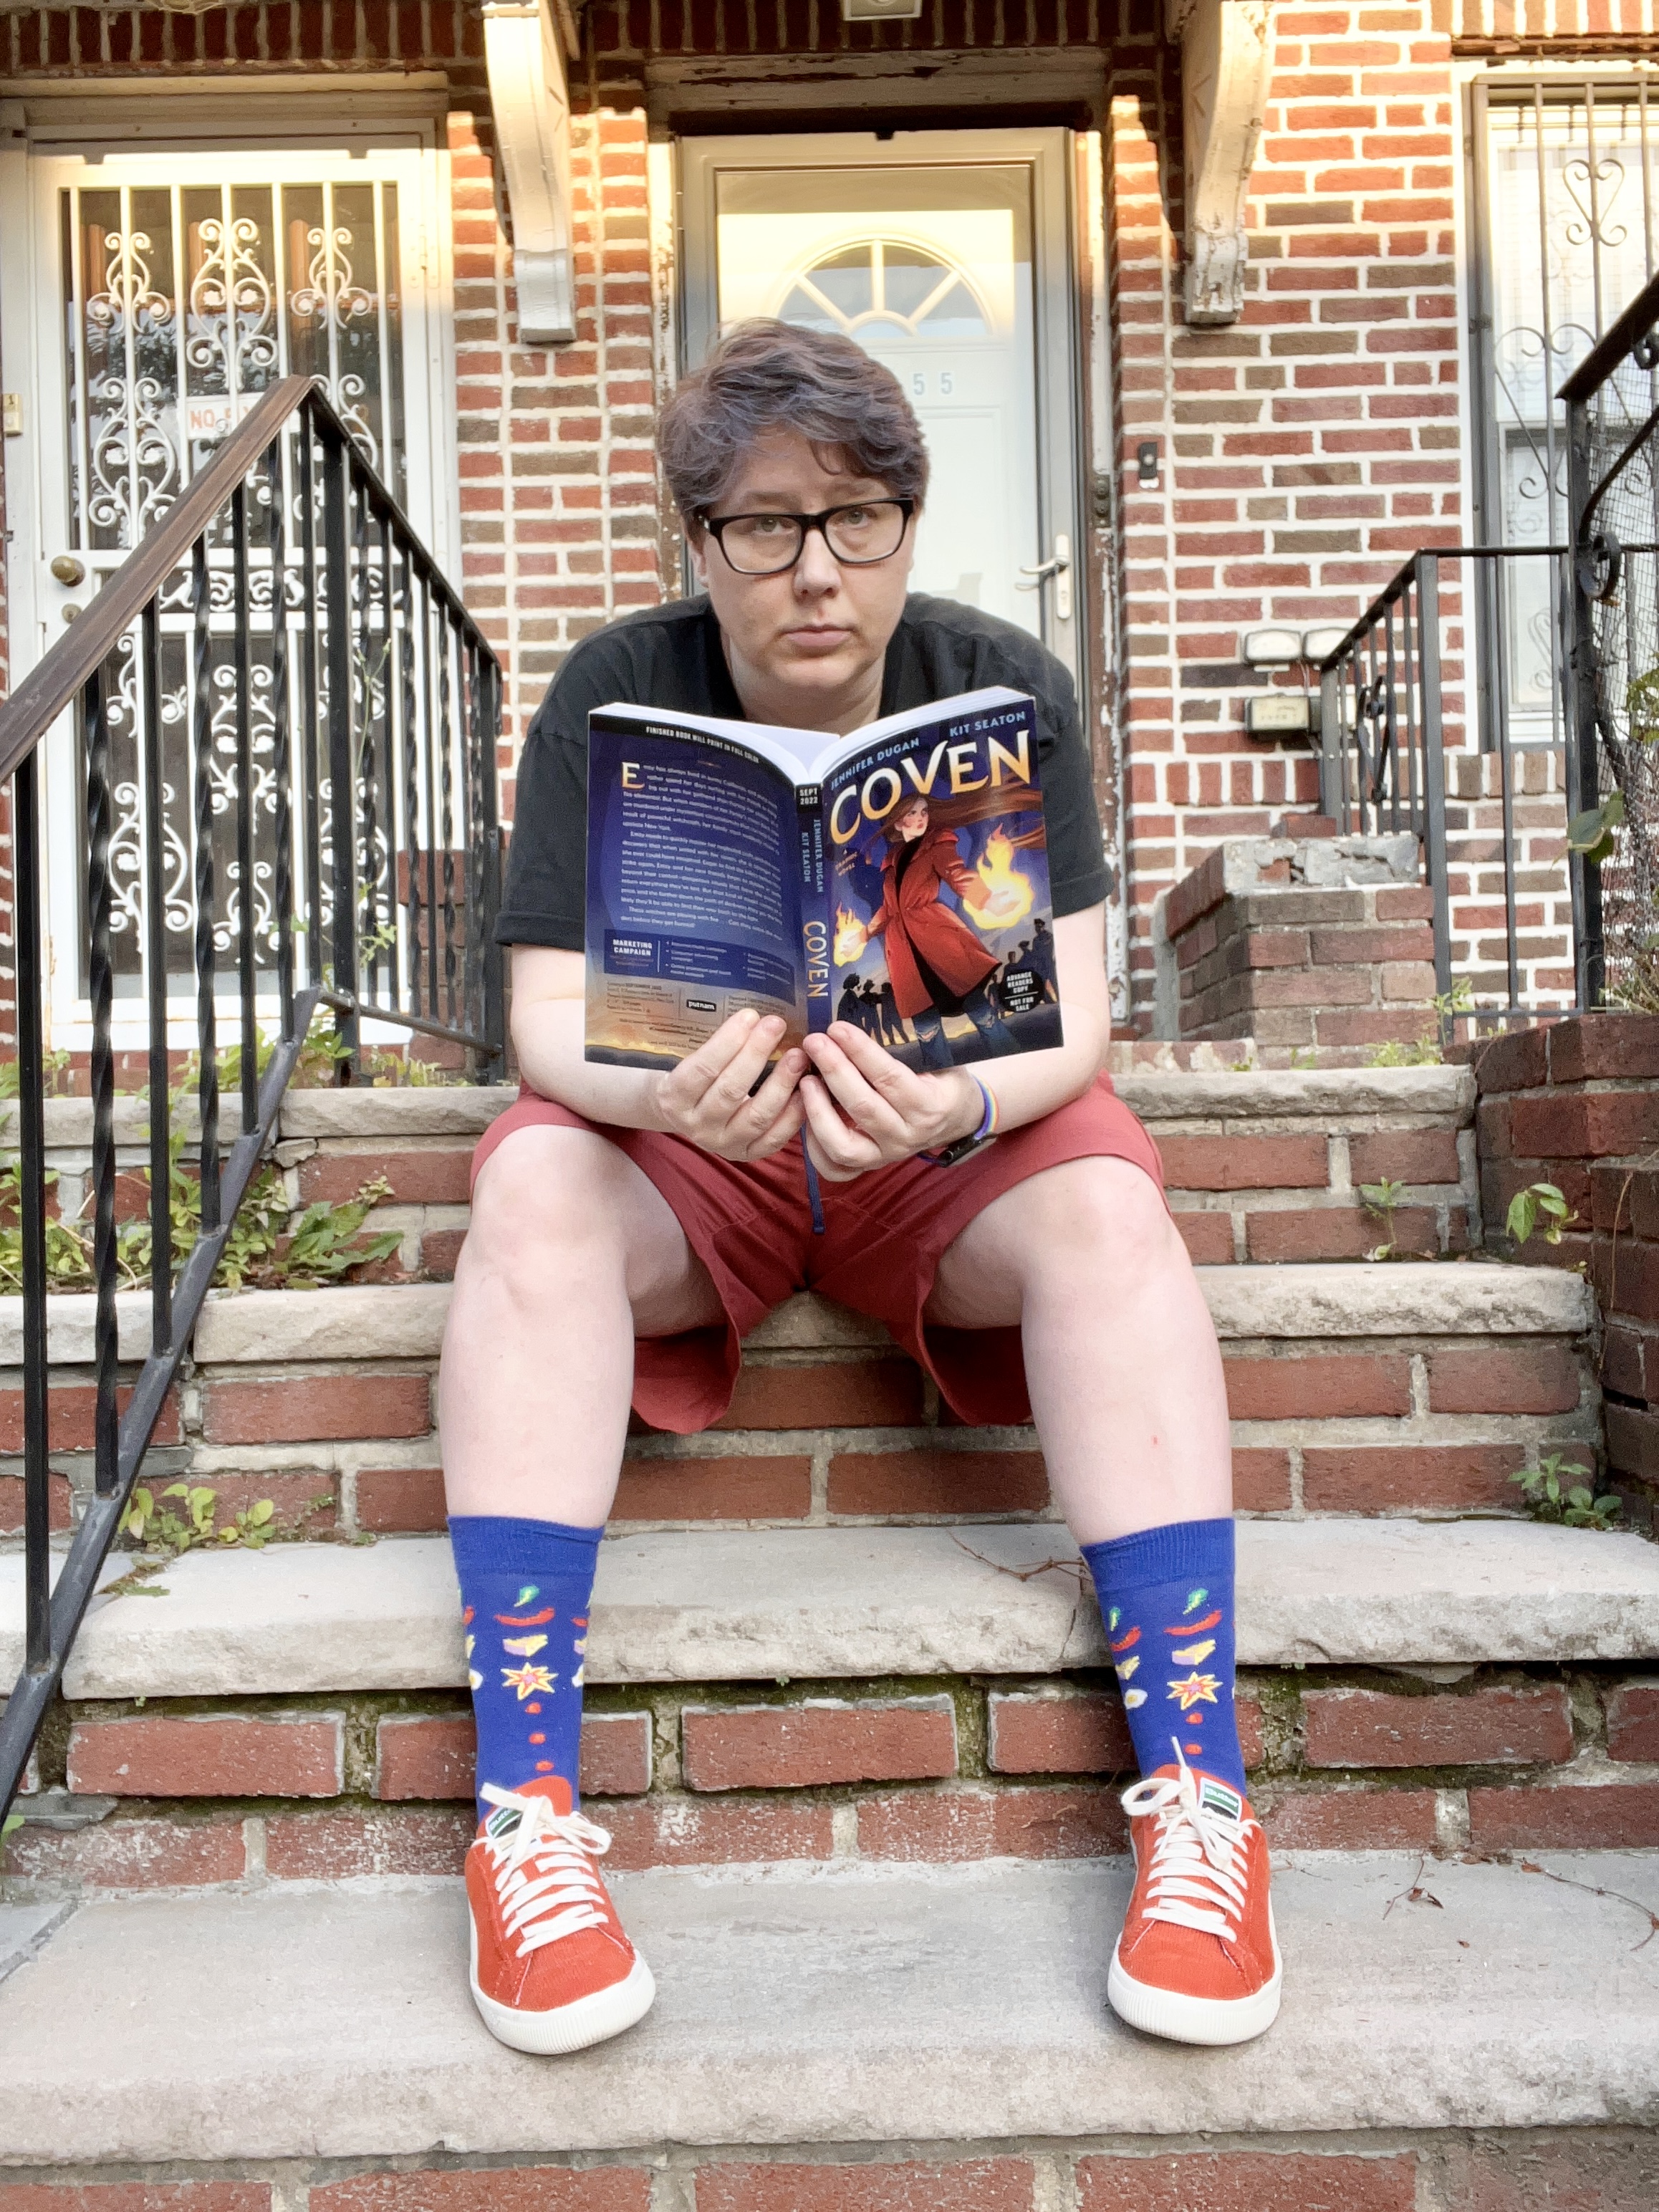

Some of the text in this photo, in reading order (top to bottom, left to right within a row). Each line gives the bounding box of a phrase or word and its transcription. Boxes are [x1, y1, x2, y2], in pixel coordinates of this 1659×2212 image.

[948, 711, 1026, 738] KIT SEATON
[646, 726, 759, 764] FINISHED BOOK WILL PRINT IN FULL COLOR
[830, 737, 920, 791] JENNIFER DUGAN
[799, 787, 818, 797] SEPT
[799, 797, 818, 805] 2022
[830, 728, 1030, 845] COVEN
[802, 832, 812, 883] KIT SEATON
[813, 819, 824, 893] JENNIFER DUGAN
[612, 938, 653, 949] MARKETING
[613, 946, 651, 956] CAMPAIGN
[802, 920, 830, 998] COVEN
[688, 1001, 715, 1010] putnam
